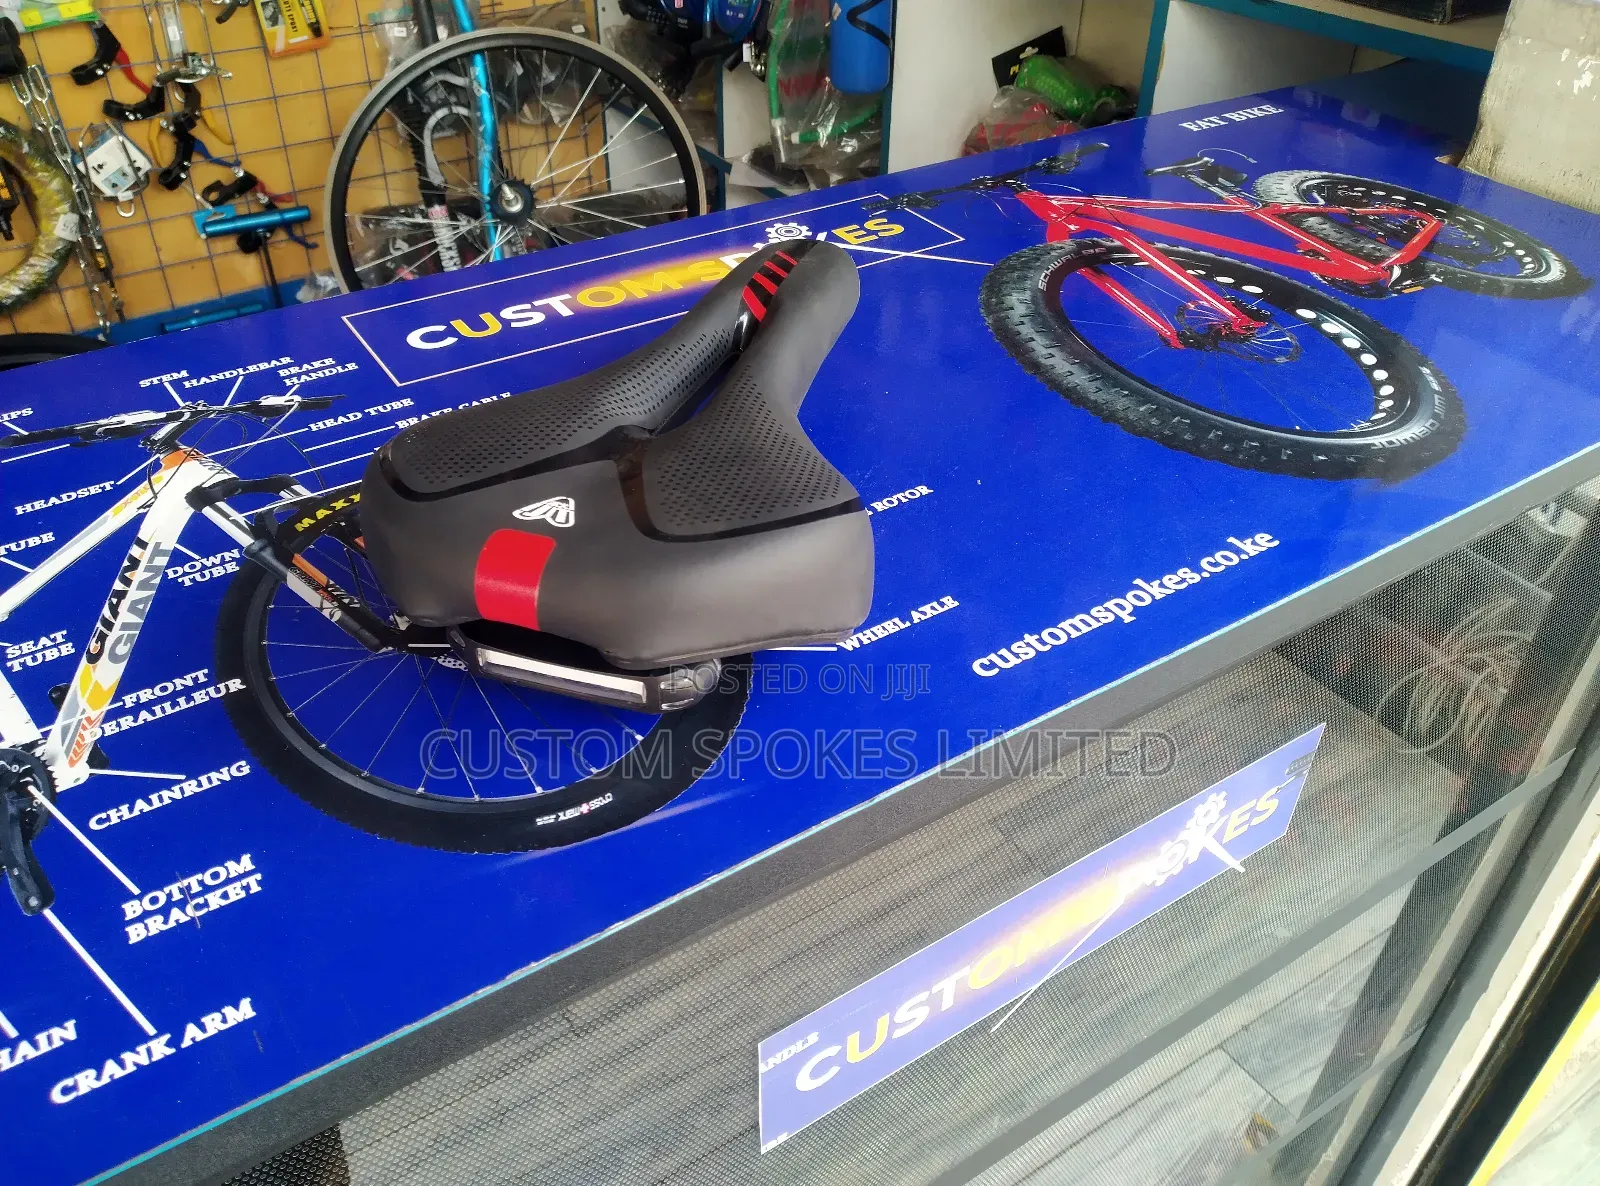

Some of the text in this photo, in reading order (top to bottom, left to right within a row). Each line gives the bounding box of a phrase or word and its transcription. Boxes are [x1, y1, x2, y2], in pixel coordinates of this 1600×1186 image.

[1179, 104, 1285, 132] FAT BIKE
[139, 370, 190, 388] STEM
[183, 356, 295, 389] HANDLEBAR
[277, 357, 337, 377] BRAKE
[283, 362, 359, 387] HANDLE
[0, 407, 34, 422] IPS
[308, 397, 415, 432] HEAD TUBE
[15, 480, 116, 516] HEADSET
[870, 485, 934, 513] ROTOR
[0, 532, 56, 556] TUBE
[164, 549, 241, 580] DOWN
[178, 561, 240, 587] TUBE
[85, 536, 150, 665] GIANT
[107, 541, 173, 665] GIANT
[971, 532, 1280, 678] customspokes.co.ke
[836, 595, 960, 652] WHEEL AXLE
[6, 630, 68, 659] SEAT
[6, 642, 76, 672] TUBE
[122, 668, 209, 709] FRONT
[84, 677, 246, 742] DERAILLEUR
[88, 760, 251, 831] CHAINRING
[120, 853, 257, 920] BOTTOM
[125, 873, 262, 944] BRACKET
[50, 996, 257, 1104] CRANK ARM
